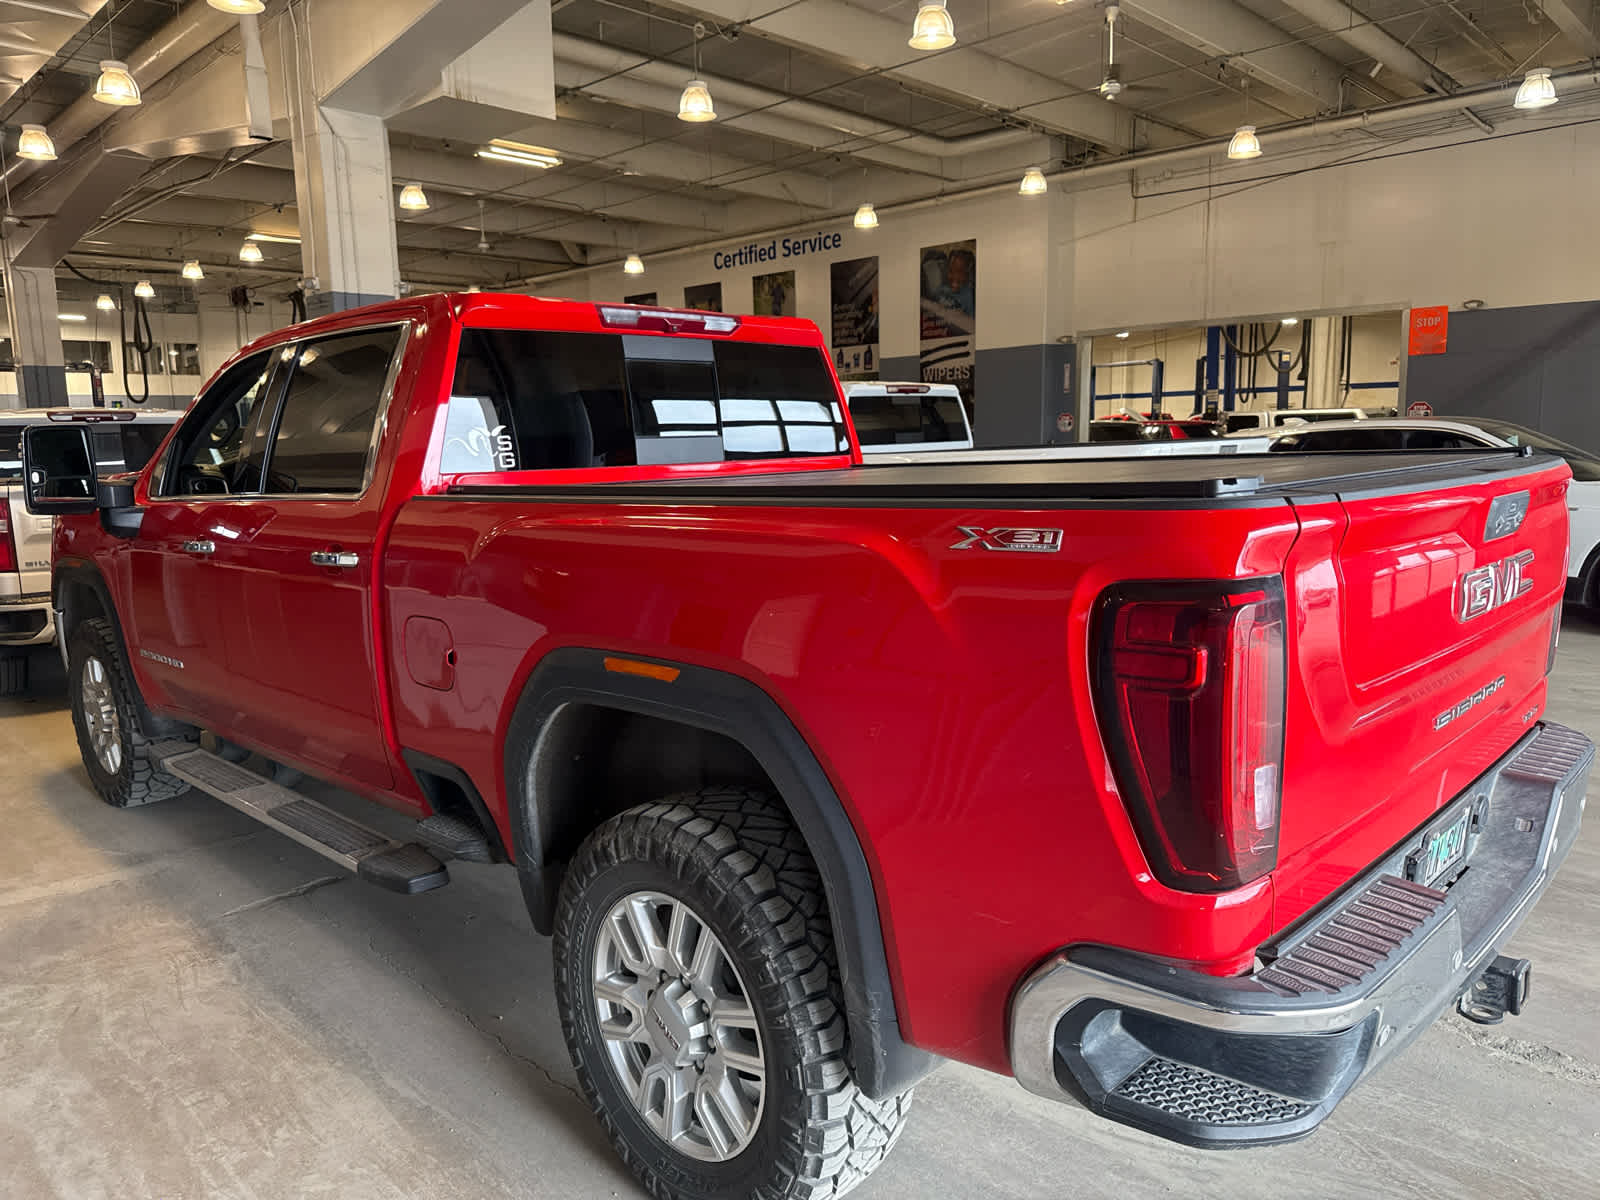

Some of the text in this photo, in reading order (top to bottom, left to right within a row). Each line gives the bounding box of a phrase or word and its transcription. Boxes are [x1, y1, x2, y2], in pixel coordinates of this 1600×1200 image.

[714, 232, 842, 270] Certified Service
[1416, 316, 1441, 328] STOP
[923, 365, 970, 382] WIPERS
[949, 525, 1060, 552] X31
[1458, 548, 1535, 624] GMC
[1432, 674, 1507, 731] SIERRA
